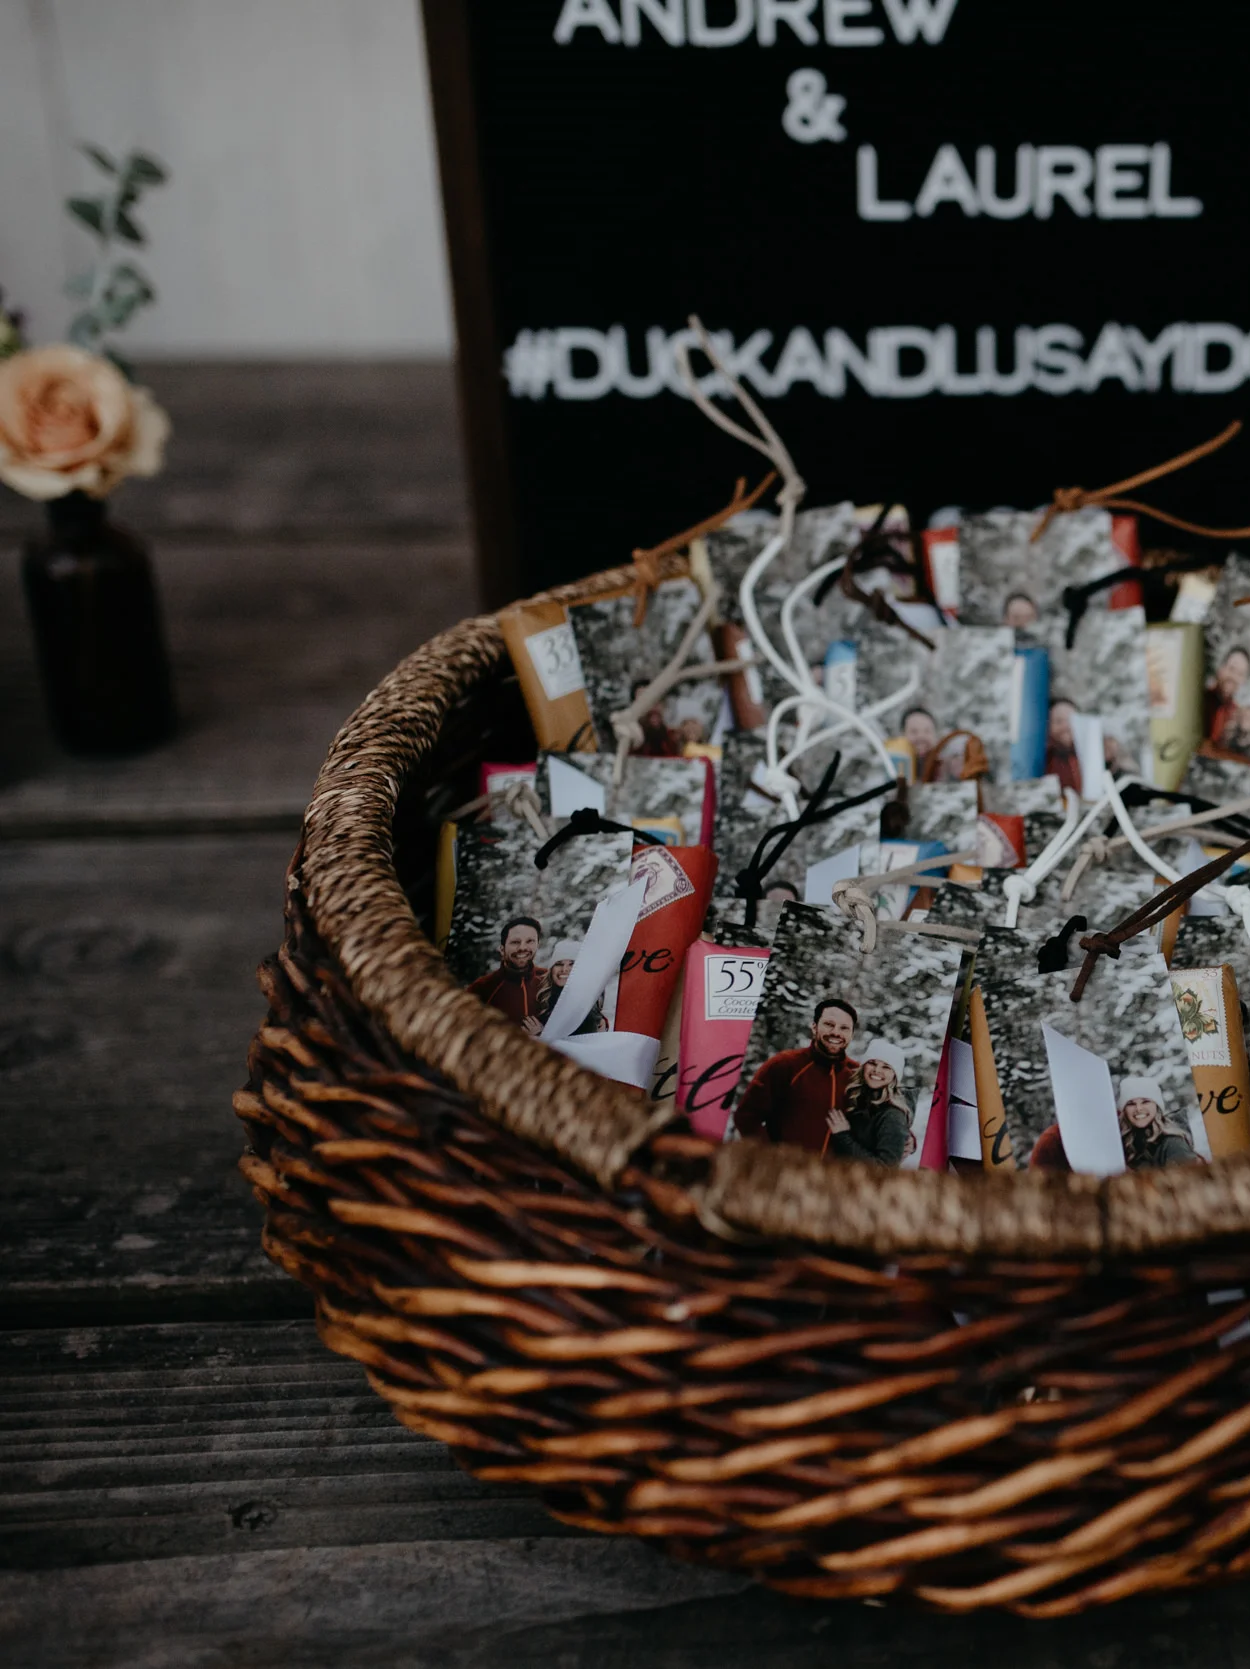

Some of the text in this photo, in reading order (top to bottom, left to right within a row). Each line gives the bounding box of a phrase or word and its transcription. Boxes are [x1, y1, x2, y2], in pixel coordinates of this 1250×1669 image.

[554, 0, 957, 46] ANDREW
[782, 69, 848, 143] &
[857, 143, 1203, 221] LAUREL
[718, 1005, 756, 1015] Conte
